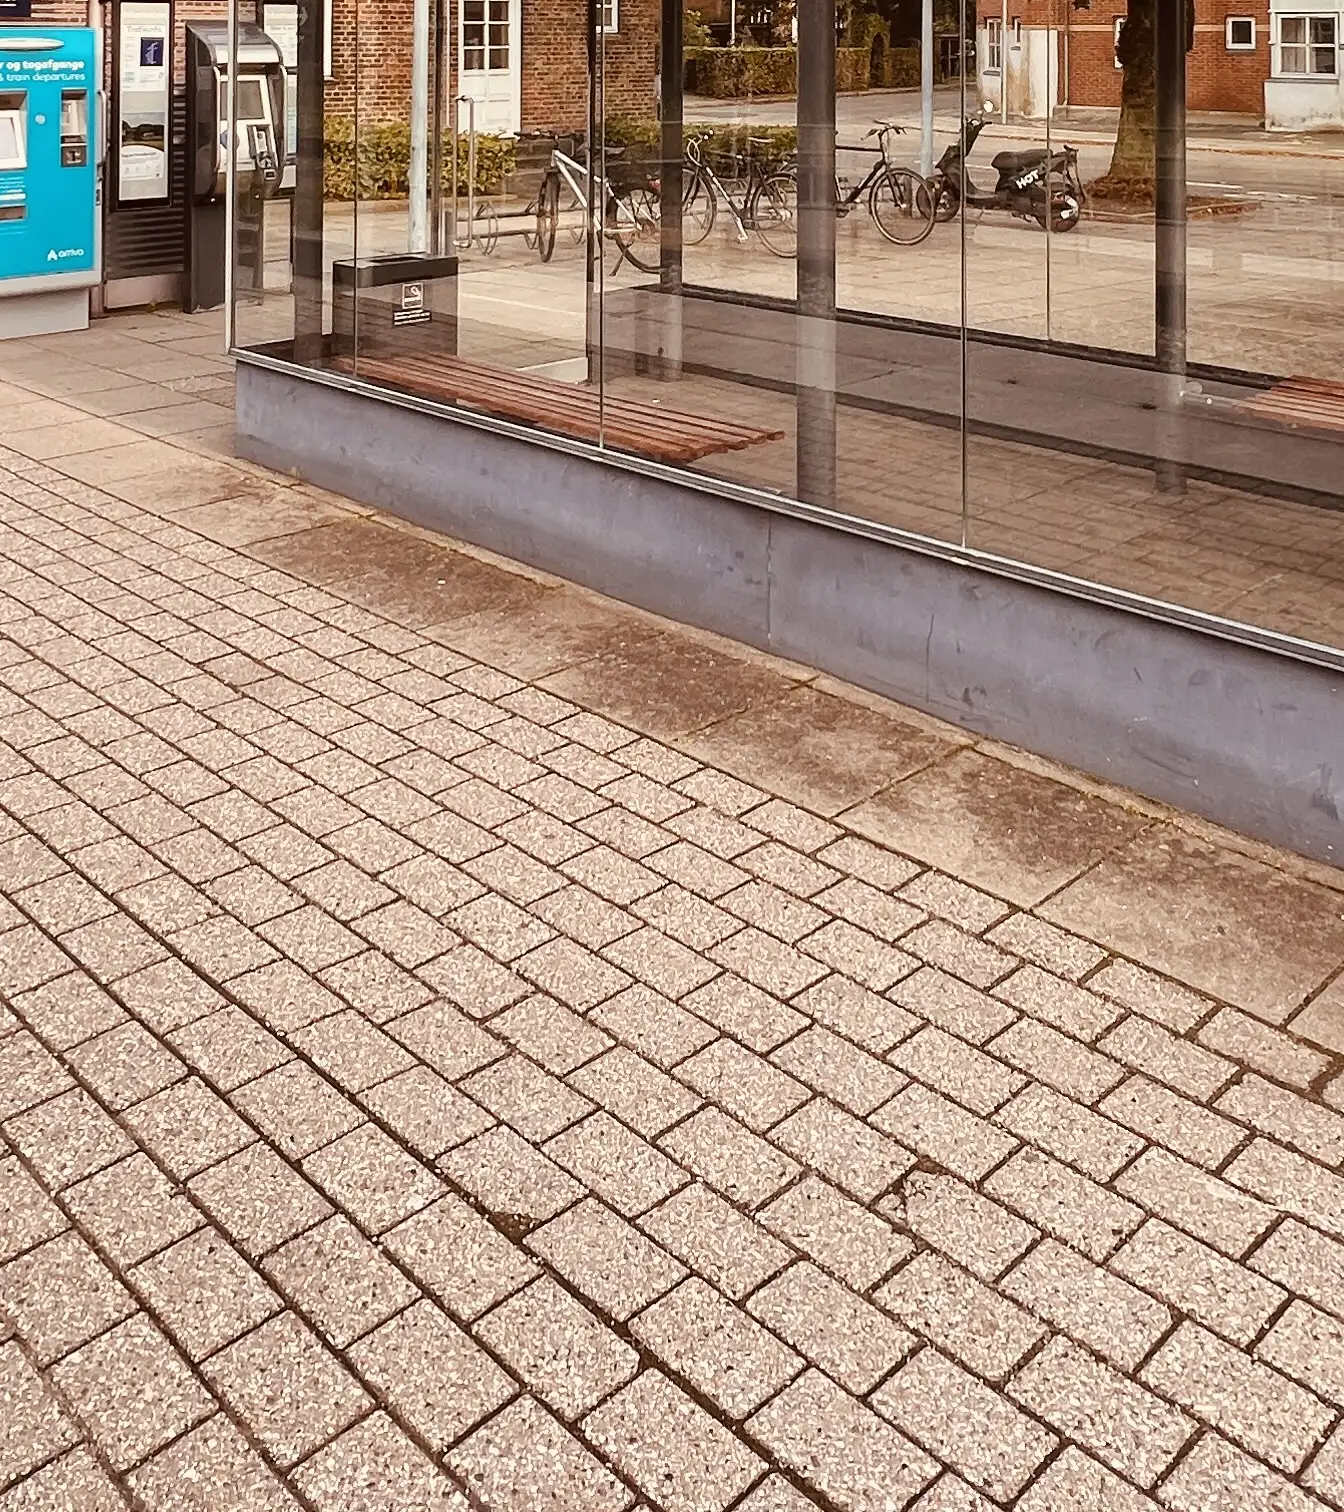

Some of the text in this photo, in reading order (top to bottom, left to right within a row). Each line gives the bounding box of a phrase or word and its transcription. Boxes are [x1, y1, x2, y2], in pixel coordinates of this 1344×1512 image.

[6, 61, 21, 71] og
[32, 73, 86, 82] departures
[1016, 169, 1039, 189] HOT
